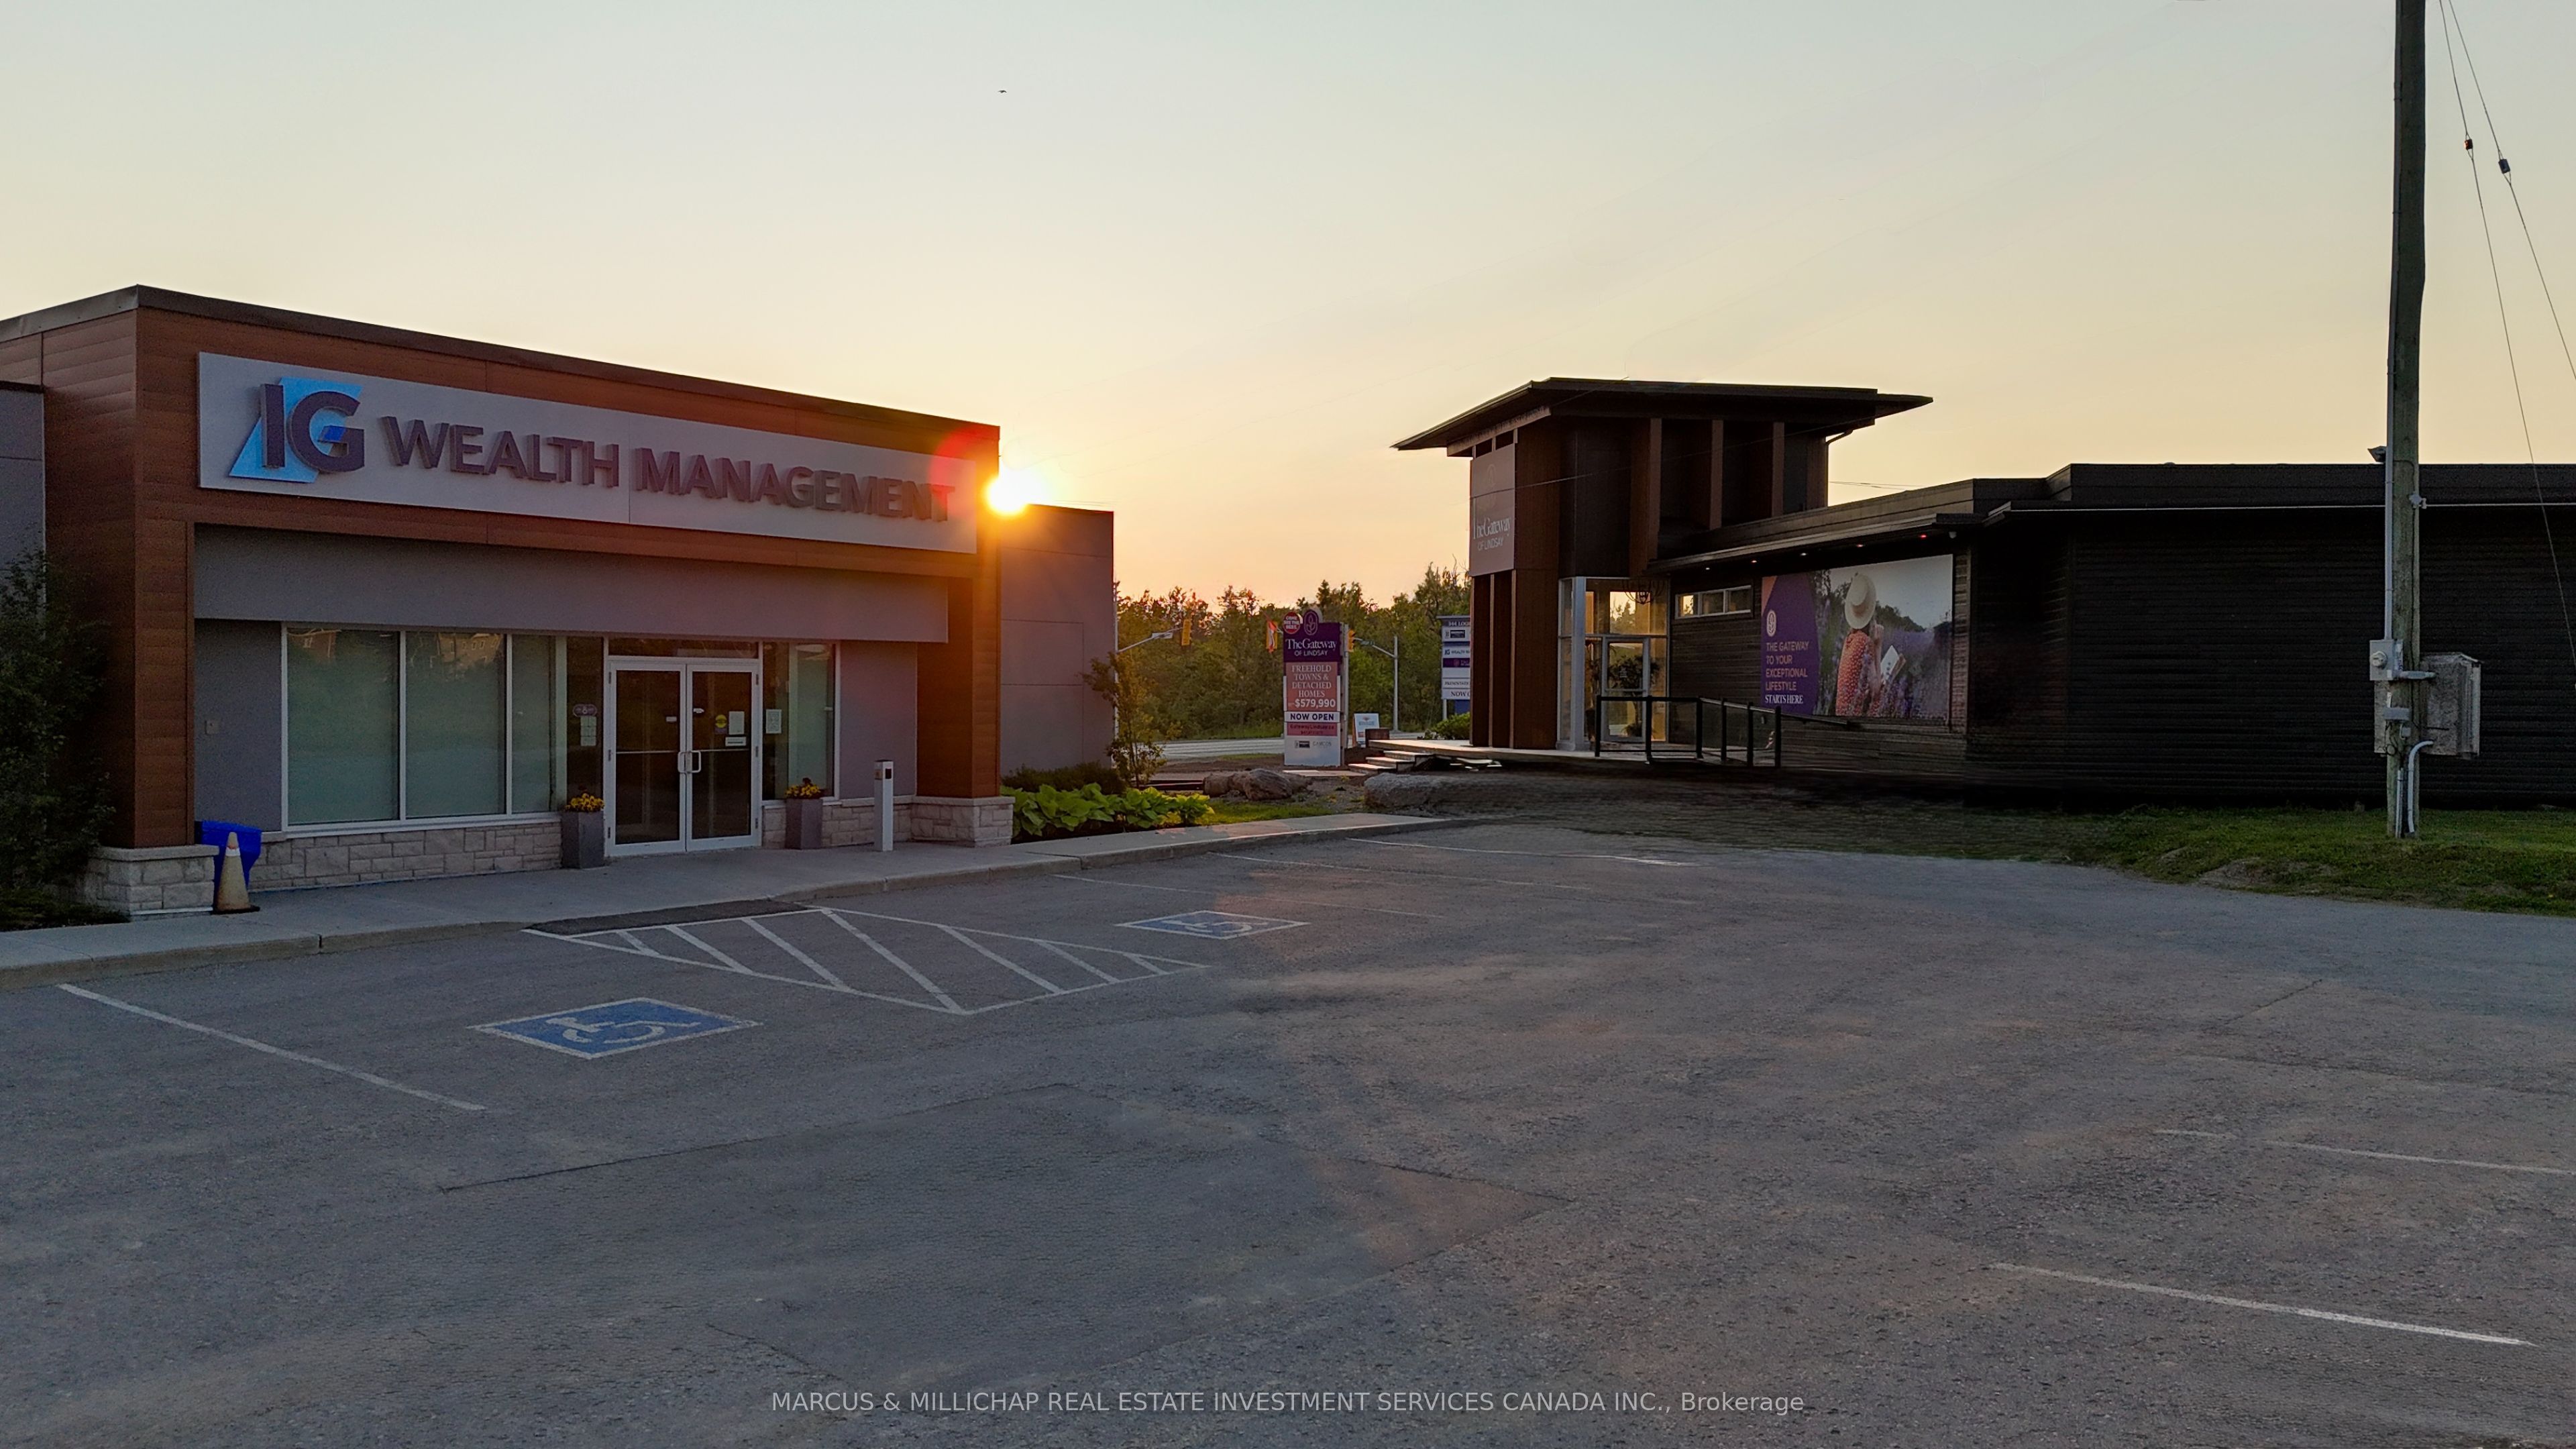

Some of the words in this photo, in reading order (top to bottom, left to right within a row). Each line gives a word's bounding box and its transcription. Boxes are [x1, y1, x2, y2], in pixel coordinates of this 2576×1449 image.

[260, 384, 365, 472] IG
[380, 415, 619, 488] WEALTH
[635, 447, 955, 522] MANAGEMENT
[1766, 642, 1778, 651] THE
[1778, 641, 1809, 651] GATEWAY
[1766, 655, 1774, 665] TO
[1776, 655, 1793, 665] YOUR
[1293, 673, 1322, 681] TOWNS
[1323, 673, 1329, 681] &
[1766, 668, 1808, 678] EXCEPTIONAL
[1766, 681, 1796, 691] LIFESTYLE
[1299, 690, 1326, 698] HOMES
[1295, 698, 1336, 708] $579,990
